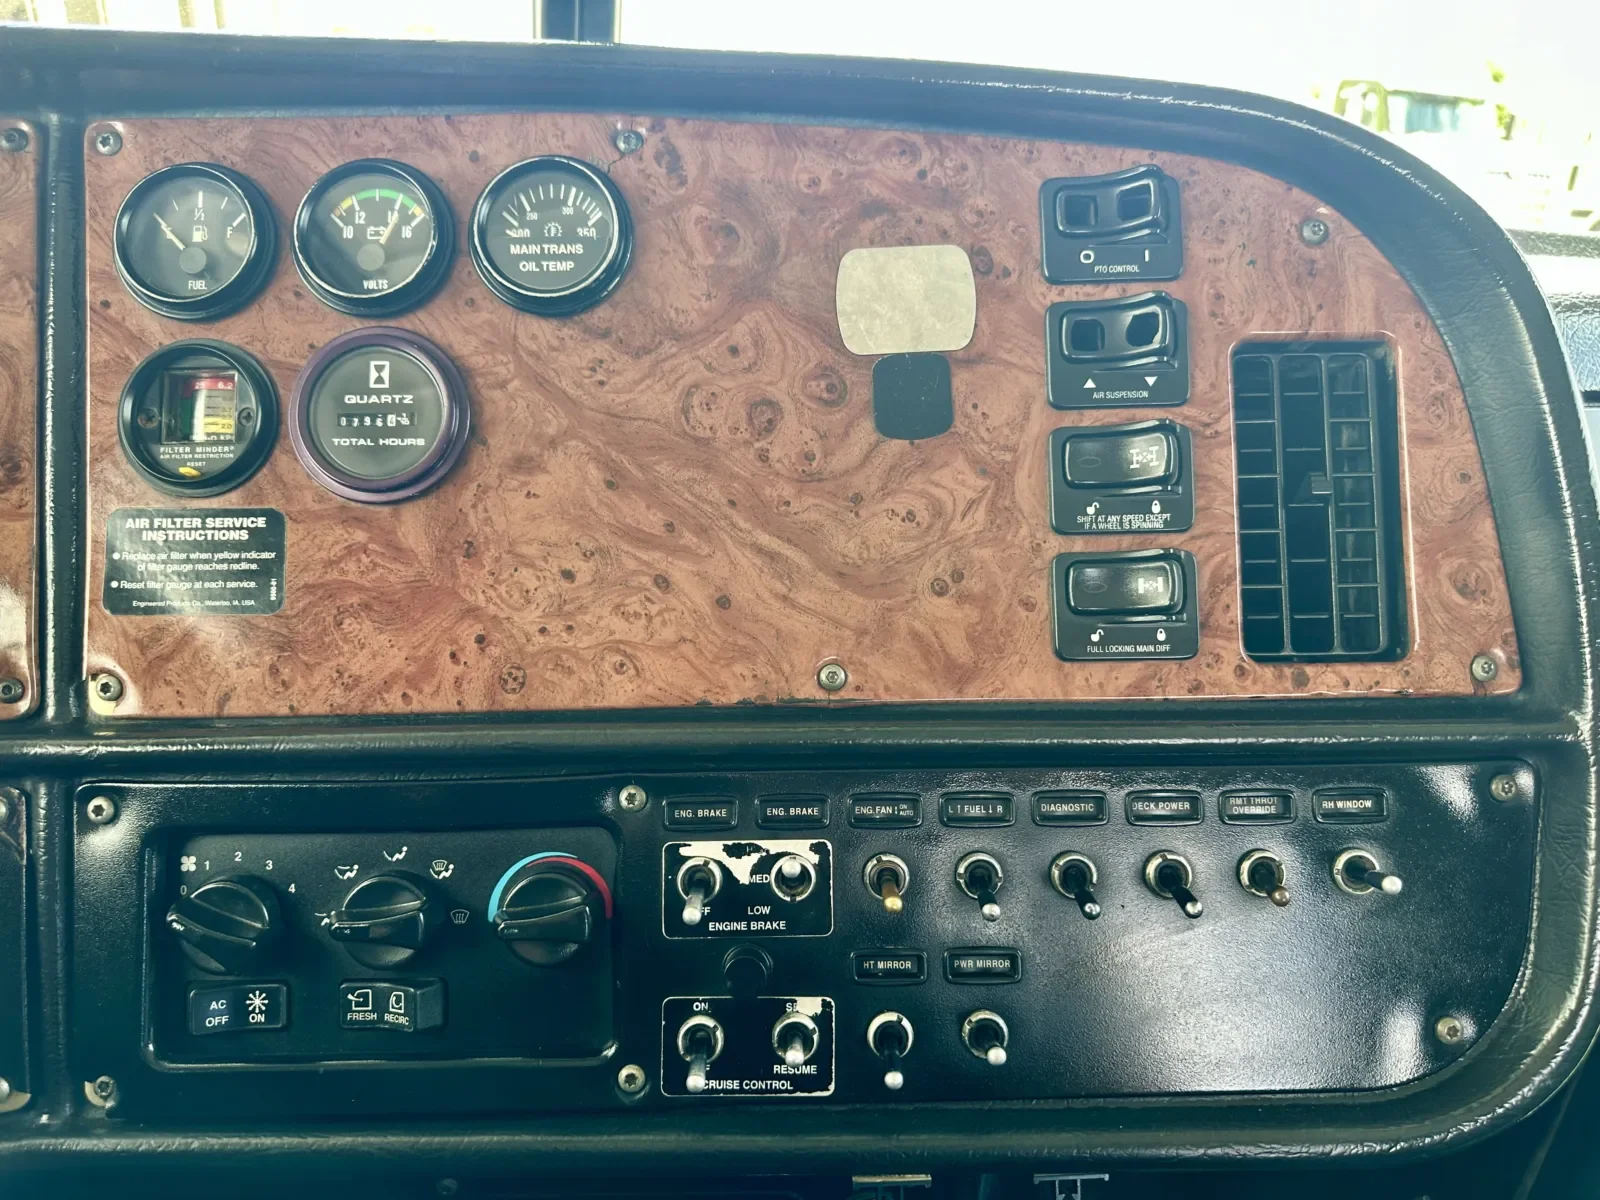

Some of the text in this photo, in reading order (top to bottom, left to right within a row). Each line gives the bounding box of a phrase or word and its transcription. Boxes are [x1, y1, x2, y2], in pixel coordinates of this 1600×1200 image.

[562, 206, 574, 216] 300
[355, 212, 366, 224] 12
[526, 212, 538, 220] 250
[227, 228, 233, 239] F
[343, 226, 354, 239] 10
[402, 226, 412, 238] 16
[510, 244, 584, 254] MAIN TRANS
[520, 261, 574, 272] OIL TEMP
[1094, 264, 1140, 274] PTO CONTROL
[188, 280, 208, 290] FUEL
[363, 280, 388, 290] VOLTS
[218, 382, 234, 390] 6.2
[344, 394, 414, 404] QUARTZ
[332, 438, 374, 446] TOTAL
[126, 517, 266, 528] AIR FILTER SERVICE
[142, 530, 249, 541] INSTRUCTIONS
[122, 552, 156, 562] Replace
[170, 552, 188, 560] filter
[214, 552, 240, 562] yellow
[138, 562, 260, 573] of filter gauge reaches redline.
[146, 580, 164, 588] filter
[167, 582, 192, 590] gauge
[194, 580, 203, 588] at
[204, 580, 224, 588] each
[226, 580, 258, 588] service.
[964, 804, 986, 812] FUEL
[997, 804, 1003, 812] R
[1041, 804, 1094, 812] DIAGNOSTIC
[1158, 802, 1190, 810] POWER
[1336, 800, 1372, 808] WINDOW
[674, 809, 727, 818] ENG. BRAKE
[766, 808, 819, 816] ENG. BRAKE
[855, 806, 892, 814] ENG. FAN
[1232, 806, 1276, 814] OVERRIDE
[234, 852, 242, 861] 2
[204, 860, 210, 870] 1
[266, 860, 272, 870] 3
[750, 874, 770, 883] MED
[180, 885, 187, 895] 0
[288, 884, 296, 893] 4
[748, 906, 770, 914] LOW
[708, 922, 786, 930] ENGINE BRAKE
[976, 960, 1010, 968] MIRROR
[210, 1000, 226, 1010] AC
[693, 1002, 708, 1011] ON
[249, 1014, 265, 1022] ON
[347, 1012, 377, 1020] FRESH
[384, 1014, 409, 1025] RECIRC
[206, 1016, 229, 1027] OFF
[774, 1065, 818, 1074] RESUME
[704, 1080, 794, 1089] CRUISE CONTROL
